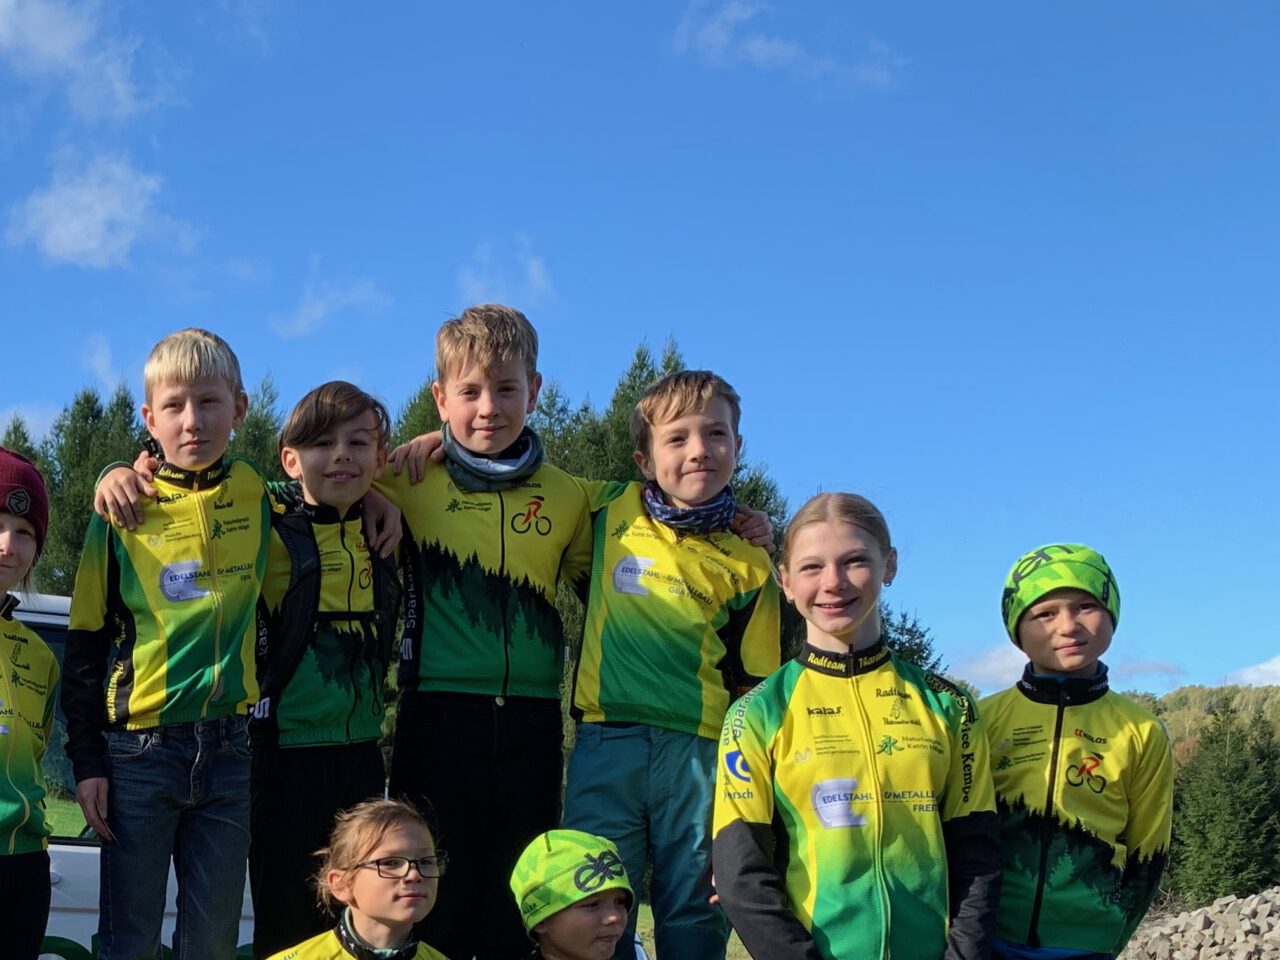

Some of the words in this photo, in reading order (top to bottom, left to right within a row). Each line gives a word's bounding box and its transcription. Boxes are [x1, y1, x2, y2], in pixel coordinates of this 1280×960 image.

[807, 652, 847, 673] Radteam
[807, 706, 842, 716] kalas
[822, 791, 875, 804] EDELSTAHL
